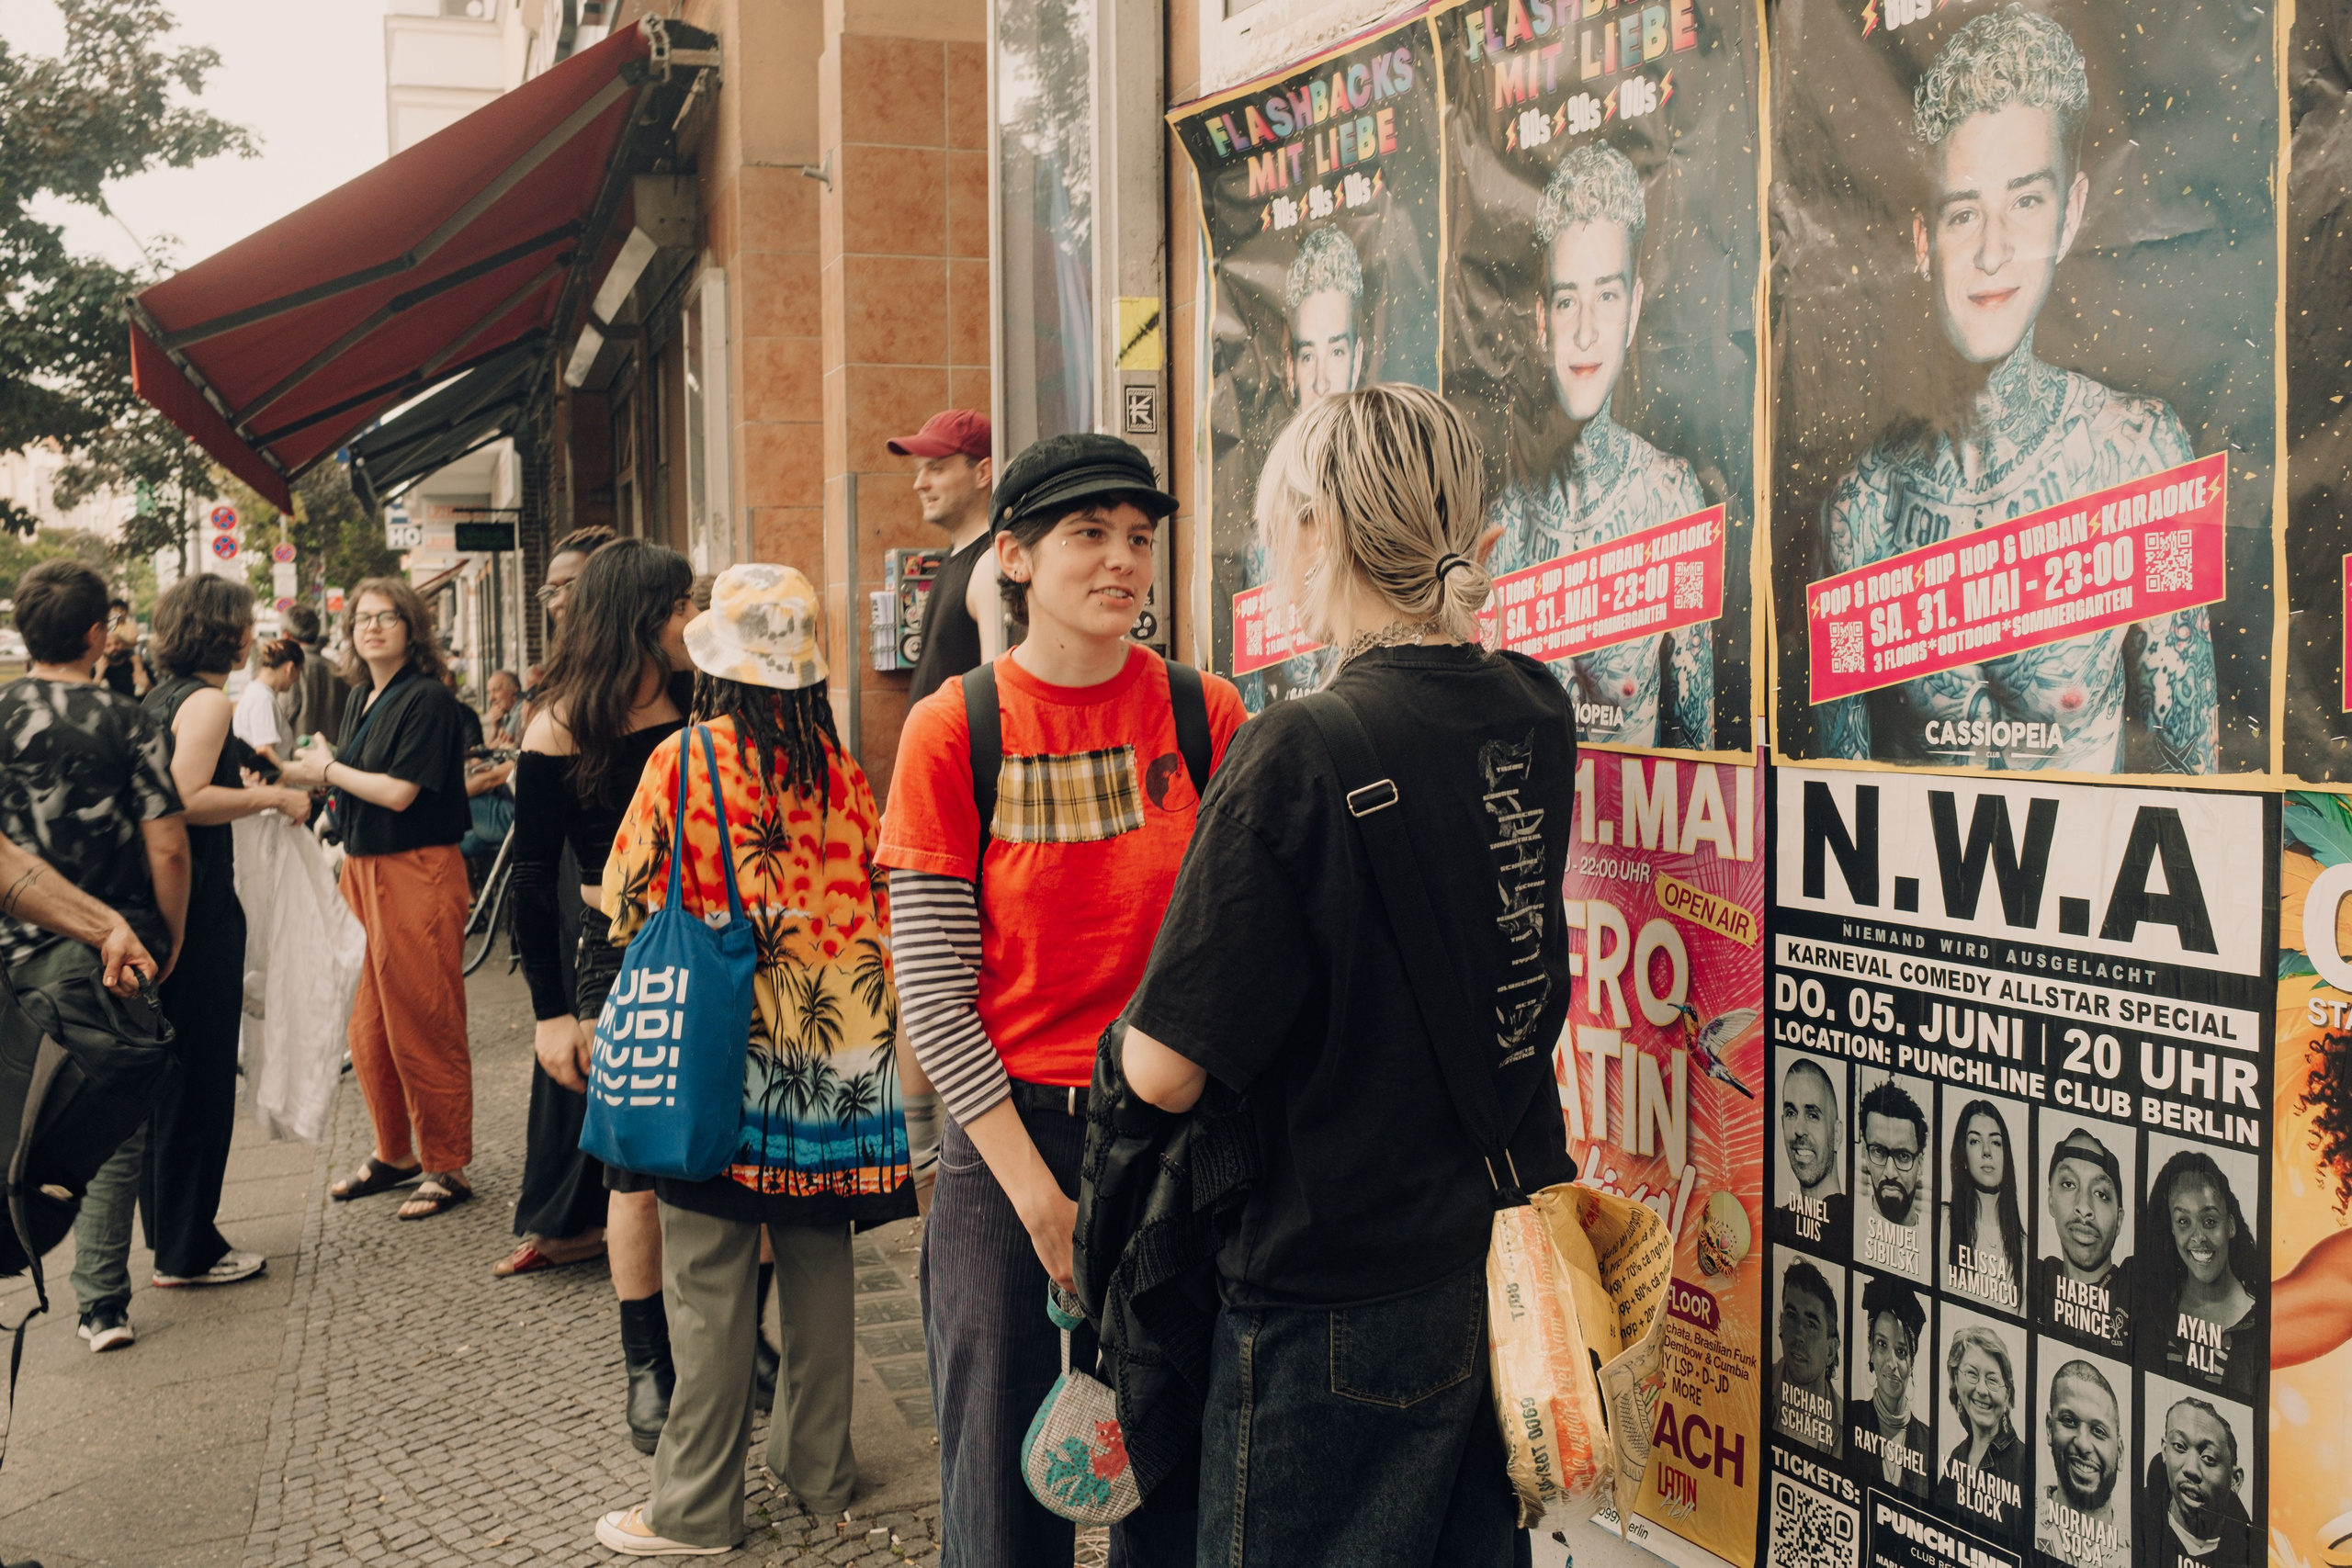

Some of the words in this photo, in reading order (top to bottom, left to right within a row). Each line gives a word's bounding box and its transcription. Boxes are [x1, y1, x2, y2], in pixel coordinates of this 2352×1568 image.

[1495, 41, 1562, 112] MIT
[1580, 0, 1698, 83] LIEBE
[1204, 47, 1414, 159] FLASHBACKS
[1519, 107, 1551, 150] 80s
[1567, 92, 1601, 135] 90s
[1620, 75, 1657, 120] 00s
[1248, 141, 1304, 198] MIT
[1314, 107, 1397, 177] LIEBE
[1506, 576, 1535, 606] ROCK
[1542, 568, 1562, 595] HIP
[1565, 561, 1587, 589] HOP
[1600, 542, 1644, 578] URBAN
[1652, 521, 1713, 562] KARAOKE
[1819, 590, 1851, 619] POP
[1868, 566, 1914, 604] ROCK
[1925, 554, 1955, 587] HIP
[1961, 541, 1997, 578] HOP
[2019, 512, 2087, 559] URBAN
[2102, 477, 2206, 536] KARAOKE
[1507, 604, 1532, 640] SA.
[1535, 596, 1562, 632] 31.
[1565, 583, 1598, 625] MAI
[1613, 563, 1669, 612] 23:00
[1870, 606, 1912, 648] SA.
[1917, 592, 1957, 635] 31.
[1962, 569, 2020, 624] MAI
[2045, 536, 2134, 602] 23:00
[1873, 651, 1883, 673] 3
[1572, 703, 1624, 728] IOPEIA
[1925, 720, 2064, 749] CASSIOPEIA
[1581, 856, 1618, 879] 22:00
[1621, 860, 1651, 884] UHR
[1803, 781, 2219, 955] N.W.A
[1664, 883, 1716, 922] OPEN
[1716, 906, 1750, 939] AIR
[1563, 898, 1688, 1028] FRO
[1842, 923, 1926, 950] NIEMAND
[1940, 939, 1989, 960] WIRD
[2006, 949, 2157, 986] AUSGELACHT
[1788, 942, 1893, 980] KARNEVAL
[1899, 962, 1991, 998] COMEDY
[2000, 978, 2109, 1019] ALLSTAR
[2119, 998, 2237, 1041] SPECIAL
[1775, 974, 1836, 1021] DO.
[1849, 987, 1905, 1036] 05.
[1918, 1001, 2023, 1061] JUNI
[2063, 1029, 2120, 1079] 20
[2140, 1042, 2261, 1110] UHR
[1552, 1018, 1687, 1180] ATIN
[1774, 1019, 1891, 1065] LOCATION:
[1898, 1043, 2044, 1100] PUNCHLINE
[2053, 1078, 2132, 1118] CLUB
[2141, 1096, 2259, 1147] BERLIN
[1789, 1191, 1830, 1224] DANIEL
[1795, 1214, 1821, 1242] LUIS
[1864, 1237, 1919, 1276] SIBILSKI
[1867, 1216, 1919, 1254] SAMUEL
[1958, 1244, 2007, 1281] ELISSA
[1949, 1264, 2018, 1308] HAMURCU
[2056, 1274, 2109, 1314] HABEN
[2054, 1298, 2111, 1339] PRINCE
[2177, 1313, 2222, 1350] AYAN
[1665, 1335, 1702, 1360] Dembow
[1705, 1352, 1712, 1365] &
[1713, 1357, 1749, 1381] Cumbia
[1667, 1324, 1692, 1344] chata,
[1695, 1333, 1732, 1359] Brasilian
[1734, 1348, 1757, 1368] Funk
[1675, 1356, 1693, 1377] LSP
[2187, 1342, 2214, 1374] ALI
[1672, 1377, 1702, 1406] MORE
[1781, 1381, 1833, 1421] RICHARD
[1521, 1397, 1544, 1440] 0069
[1781, 1405, 1834, 1447] SCHÄFER
[1652, 1401, 1745, 1488] ACH
[1854, 1426, 1928, 1477] RAYTSCHEL
[1657, 1461, 1697, 1512] LATIN
[1771, 1445, 1860, 1505] TICKETS:
[1940, 1454, 2021, 1509] KATHARINA
[1957, 1482, 2003, 1523] BLOCK
[2048, 1498, 2119, 1551] NORMAN
[1628, 1521, 1648, 1540] erlin
[2061, 1529, 2102, 1567] SOSA
[1911, 1547, 1935, 1566] CLUB
